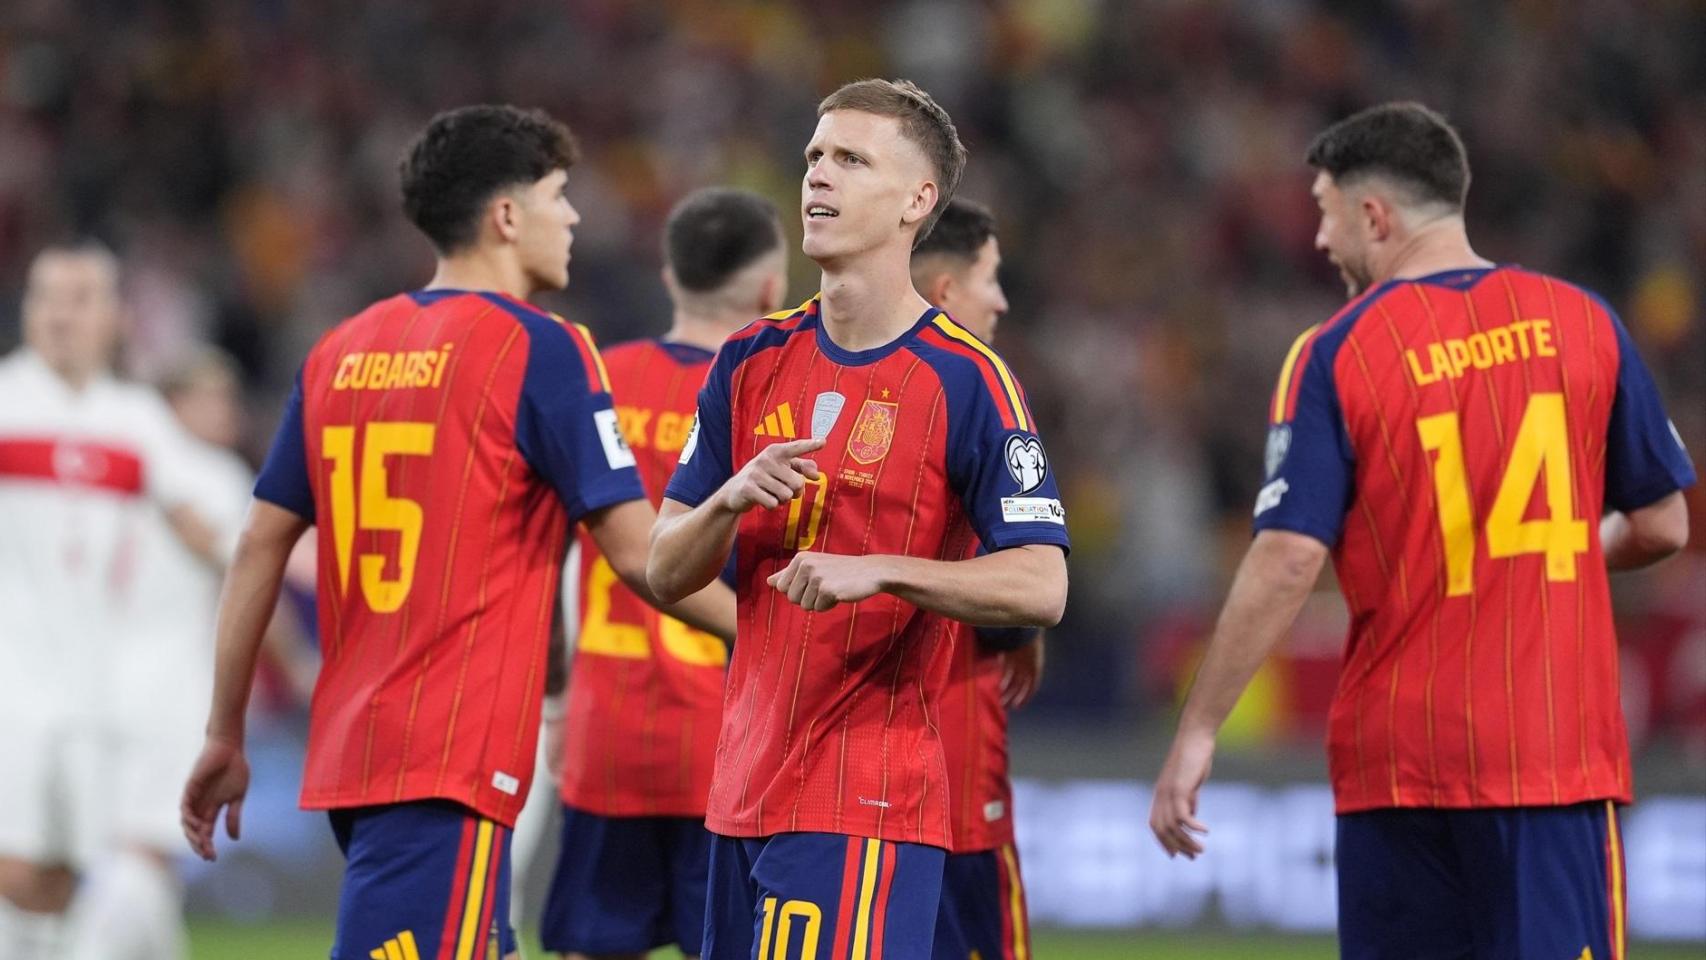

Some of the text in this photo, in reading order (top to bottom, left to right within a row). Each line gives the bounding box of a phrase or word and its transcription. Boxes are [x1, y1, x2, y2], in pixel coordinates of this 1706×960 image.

[333, 343, 453, 390] CUBARSÍ
[1406, 319, 1556, 386] LAPORTE
[322, 421, 436, 613] 15
[1416, 392, 1589, 597] 14
[758, 897, 822, 960] 10
